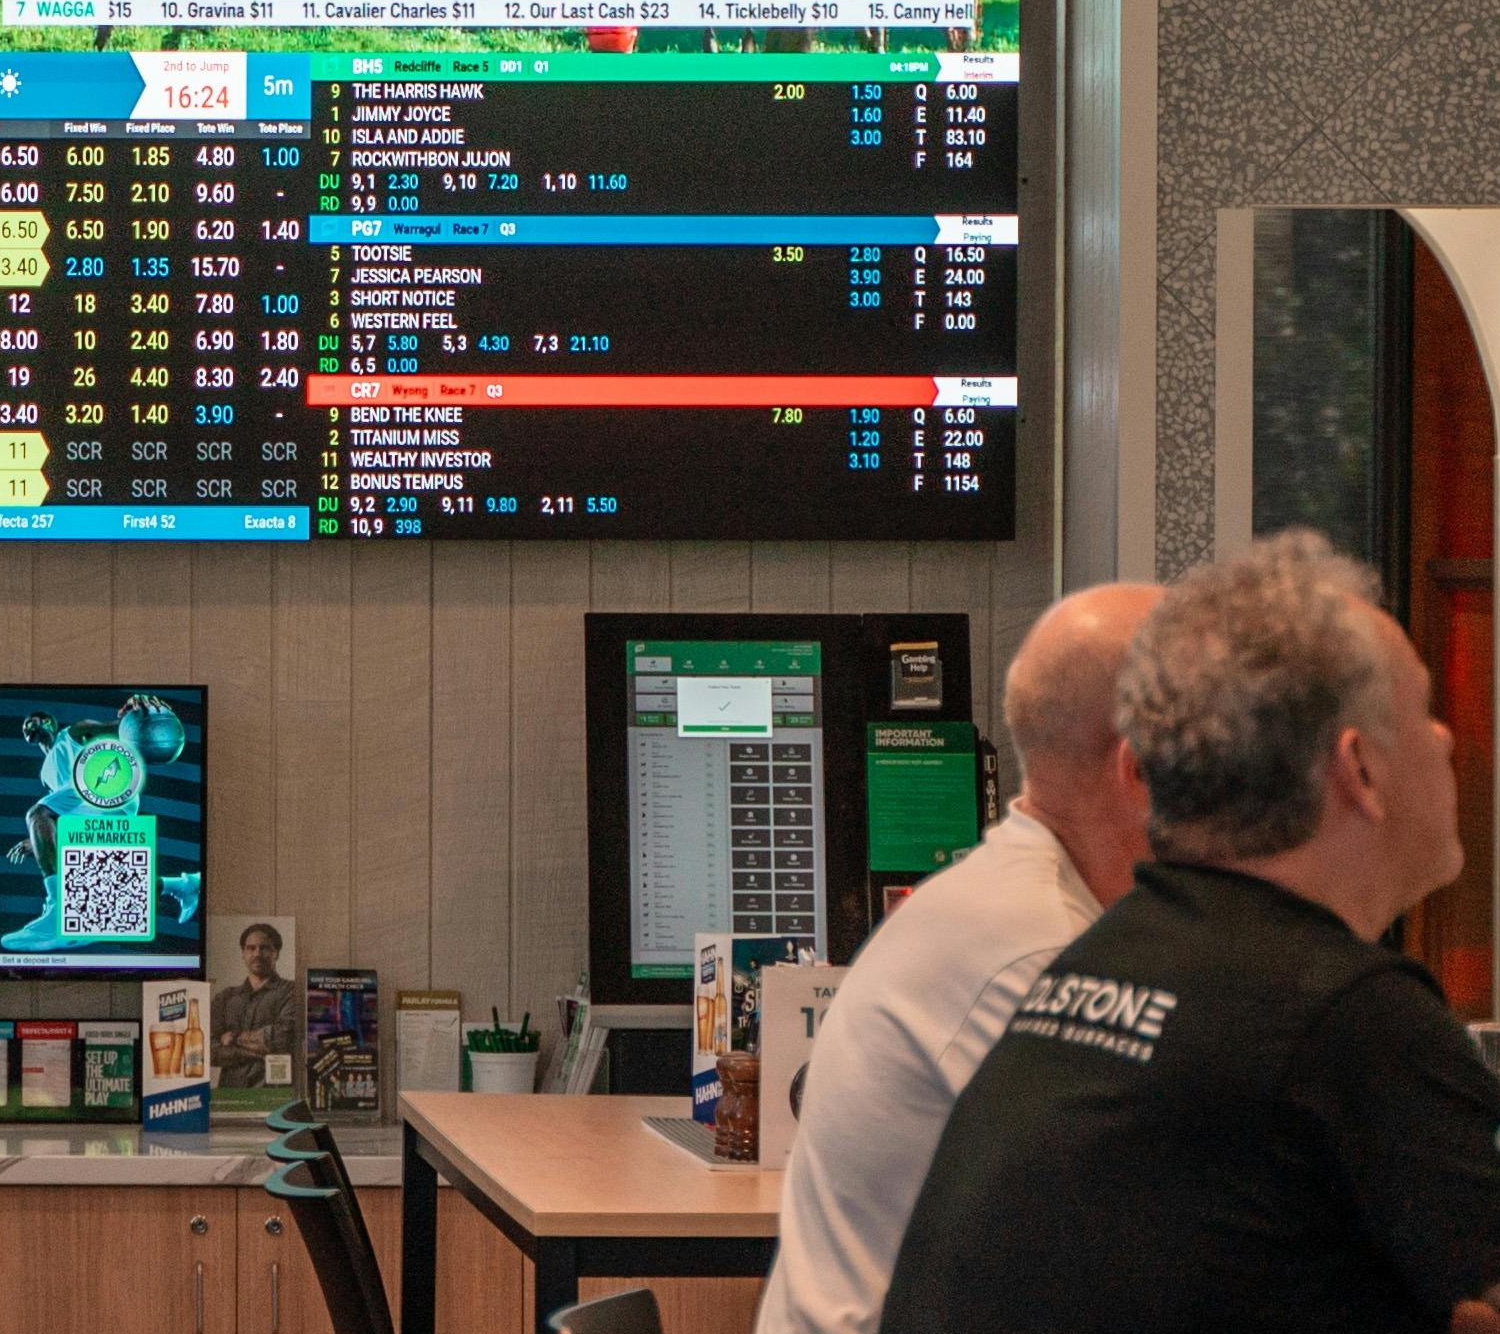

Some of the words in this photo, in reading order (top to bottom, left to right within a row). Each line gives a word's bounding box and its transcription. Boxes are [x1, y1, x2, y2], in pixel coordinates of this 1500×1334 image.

[164, 85, 229, 109] 16:24
[352, 84, 381, 99] THE
[385, 84, 437, 100] HARRIS
[440, 84, 483, 100] HAWK
[352, 151, 457, 167] ROCKWITHBON
[462, 151, 510, 167] JUJON
[350, 430, 419, 446] TITANIUM
[423, 430, 459, 446] MISS
[350, 452, 417, 468] WEALTHY
[421, 452, 492, 468] INVESTOR
[85, 819, 113, 830] SCAN
[117, 819, 129, 830] TO
[69, 832, 94, 843] VIEW
[97, 832, 146, 843] MARKETS
[86, 1078, 131, 1092] ULTIMATE
[150, 1095, 188, 1119] HAHN
